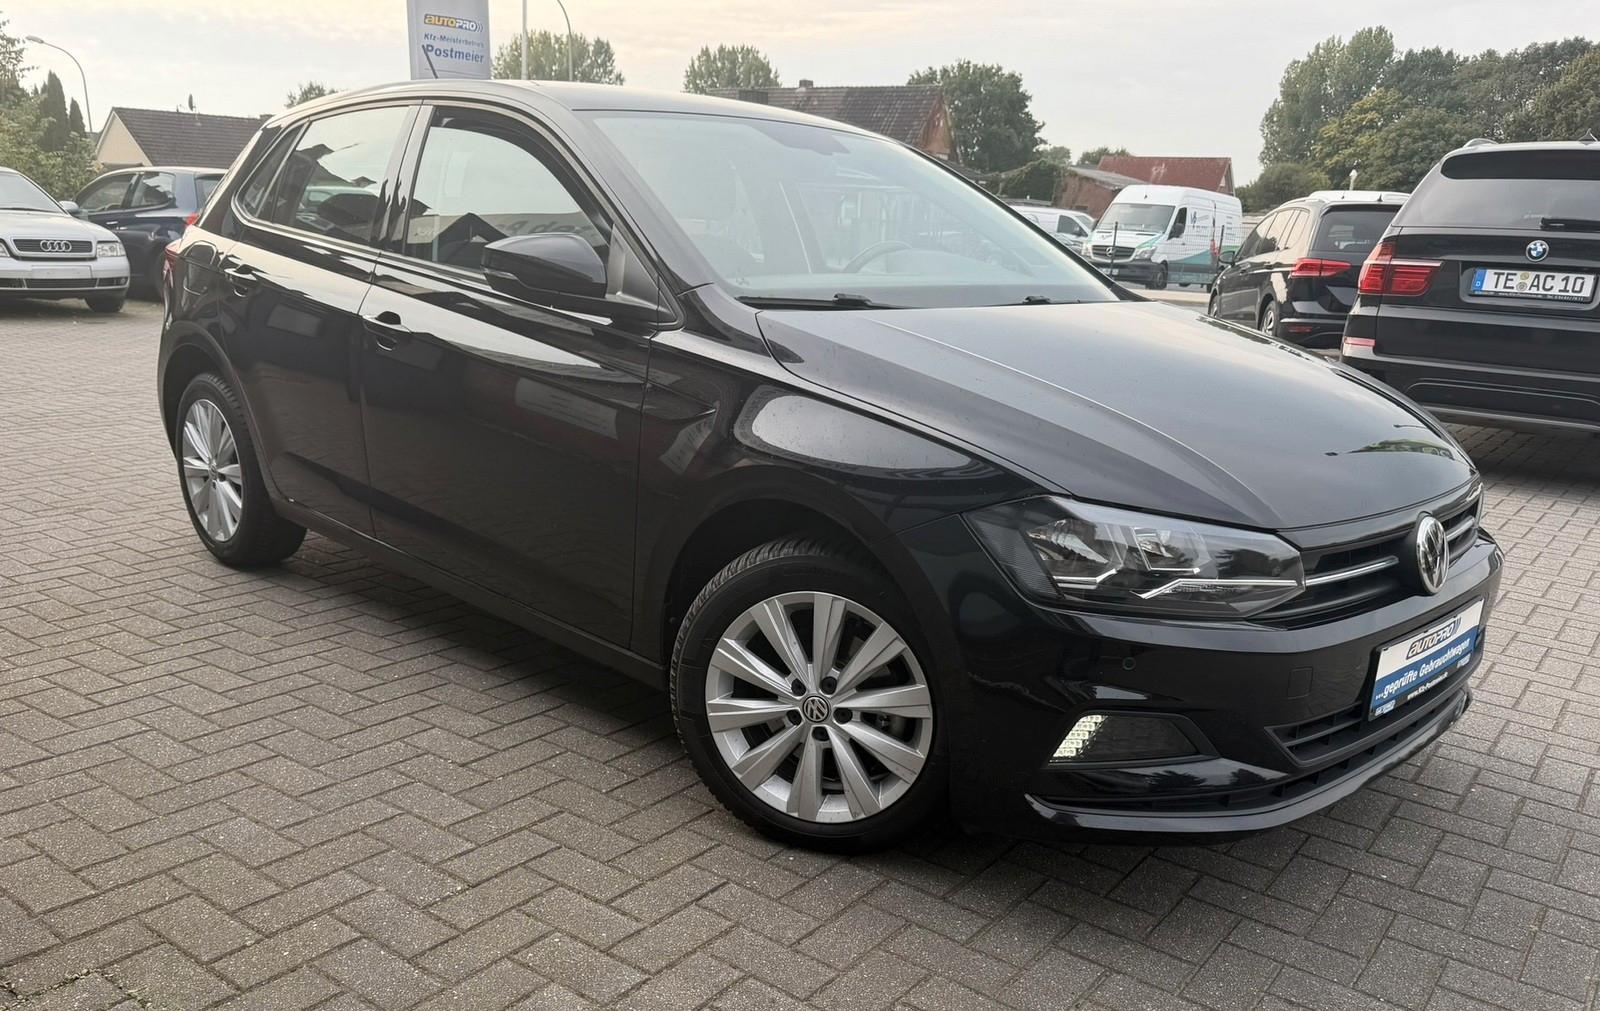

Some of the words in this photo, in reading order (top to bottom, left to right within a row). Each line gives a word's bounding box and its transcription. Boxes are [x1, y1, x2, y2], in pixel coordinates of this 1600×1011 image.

[425, 44, 484, 63] Postmeier
[1493, 272, 1517, 290] TE
[1528, 274, 1555, 291] AC
[1558, 276, 1585, 293] 10
[1419, 638, 1470, 677] Gebrauchtwagen
